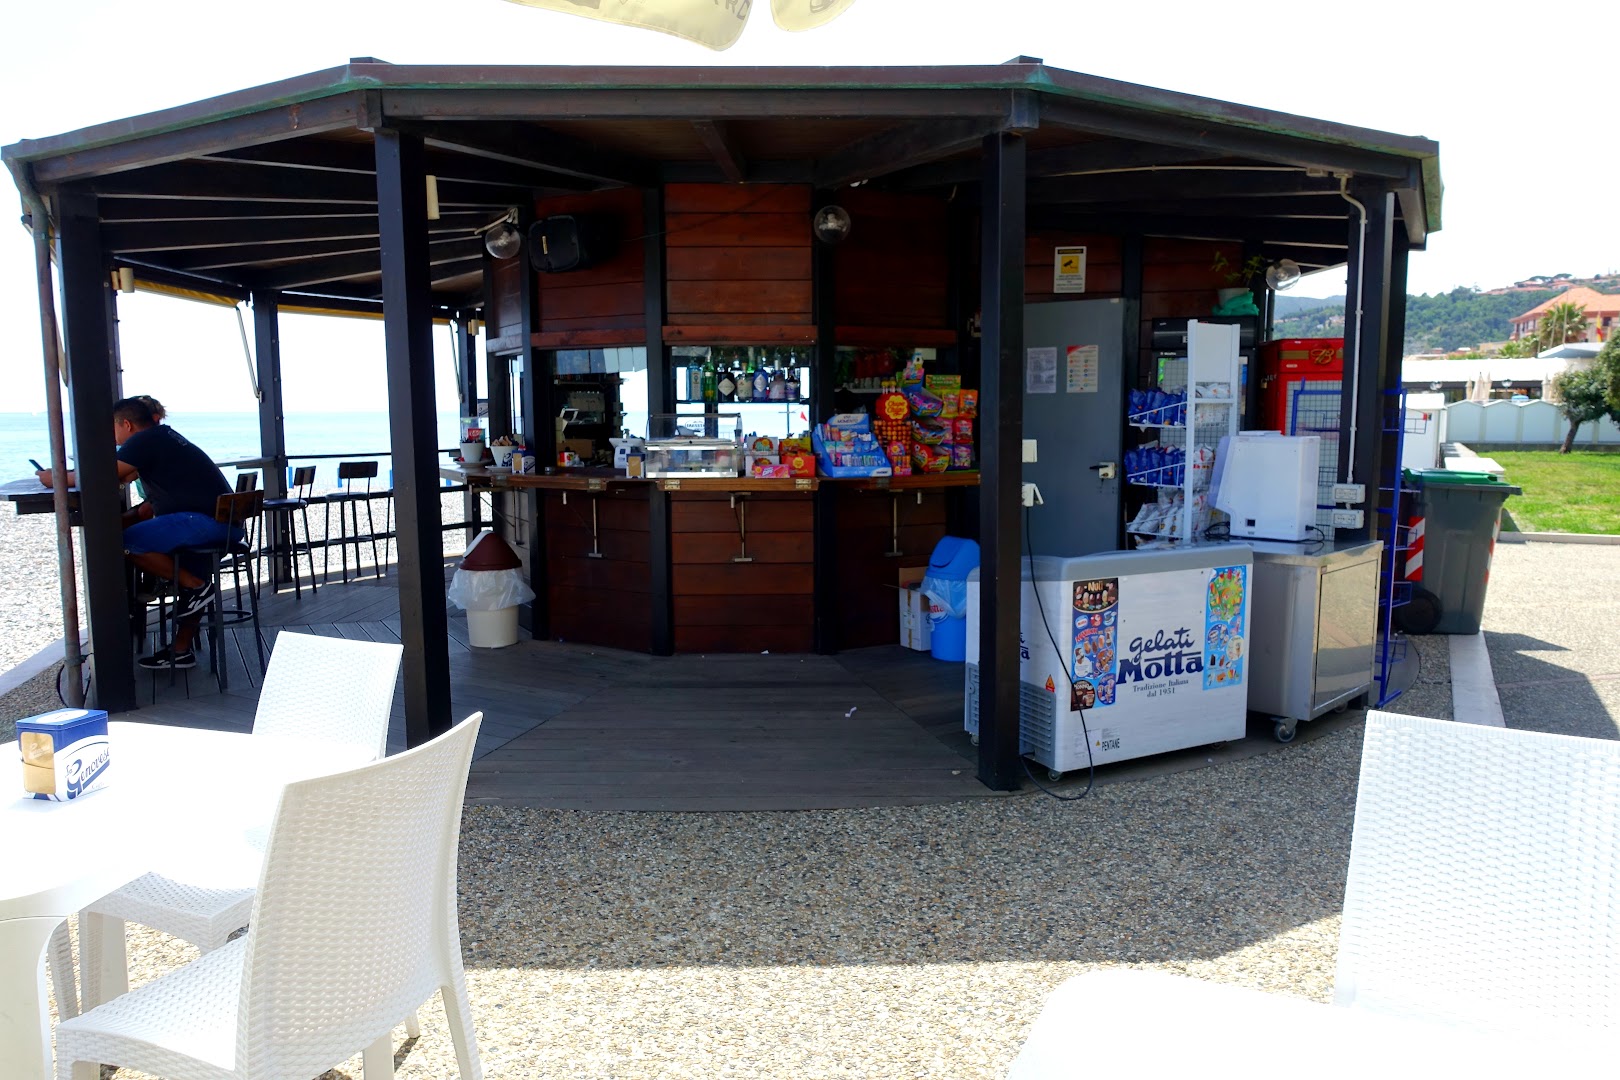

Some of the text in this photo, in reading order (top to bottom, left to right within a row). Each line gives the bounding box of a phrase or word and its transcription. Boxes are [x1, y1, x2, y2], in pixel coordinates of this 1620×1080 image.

[1129, 627, 1195, 663] gelati
[1116, 650, 1204, 685] Motta
[1133, 679, 1189, 692] Tradizione Italiana
[1159, 687, 1175, 696] 1951
[1102, 738, 1120, 751] PENTANE
